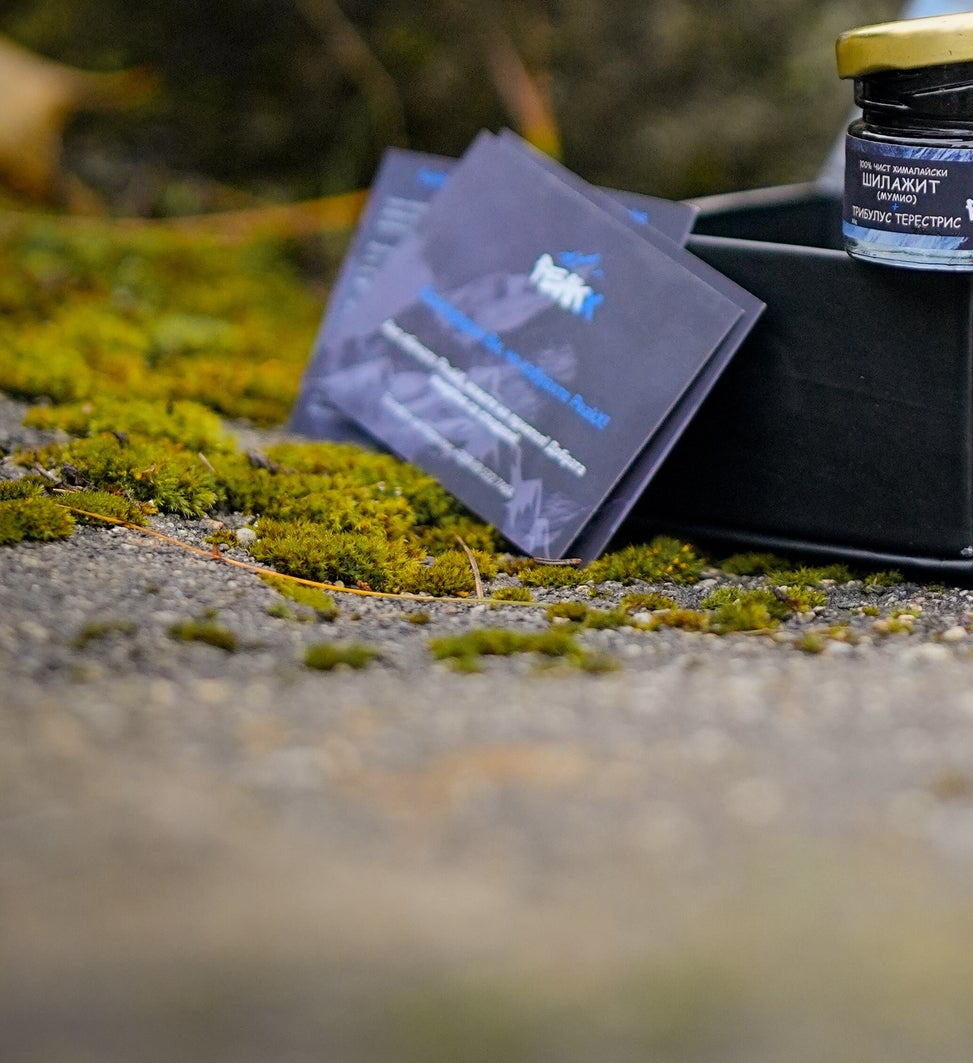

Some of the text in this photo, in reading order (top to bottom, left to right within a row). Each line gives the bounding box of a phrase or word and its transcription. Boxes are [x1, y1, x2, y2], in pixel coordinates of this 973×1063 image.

[859, 159, 948, 177] 100% ЧИСТ ХИМАЛАЙСКИ
[862, 171, 941, 194] ШИЛАЖИТ
[877, 190, 917, 205] (МУМИО)
[852, 205, 892, 223] ТРИБУЛУС
[895, 213, 962, 229] ТЕРЕСТРИС
